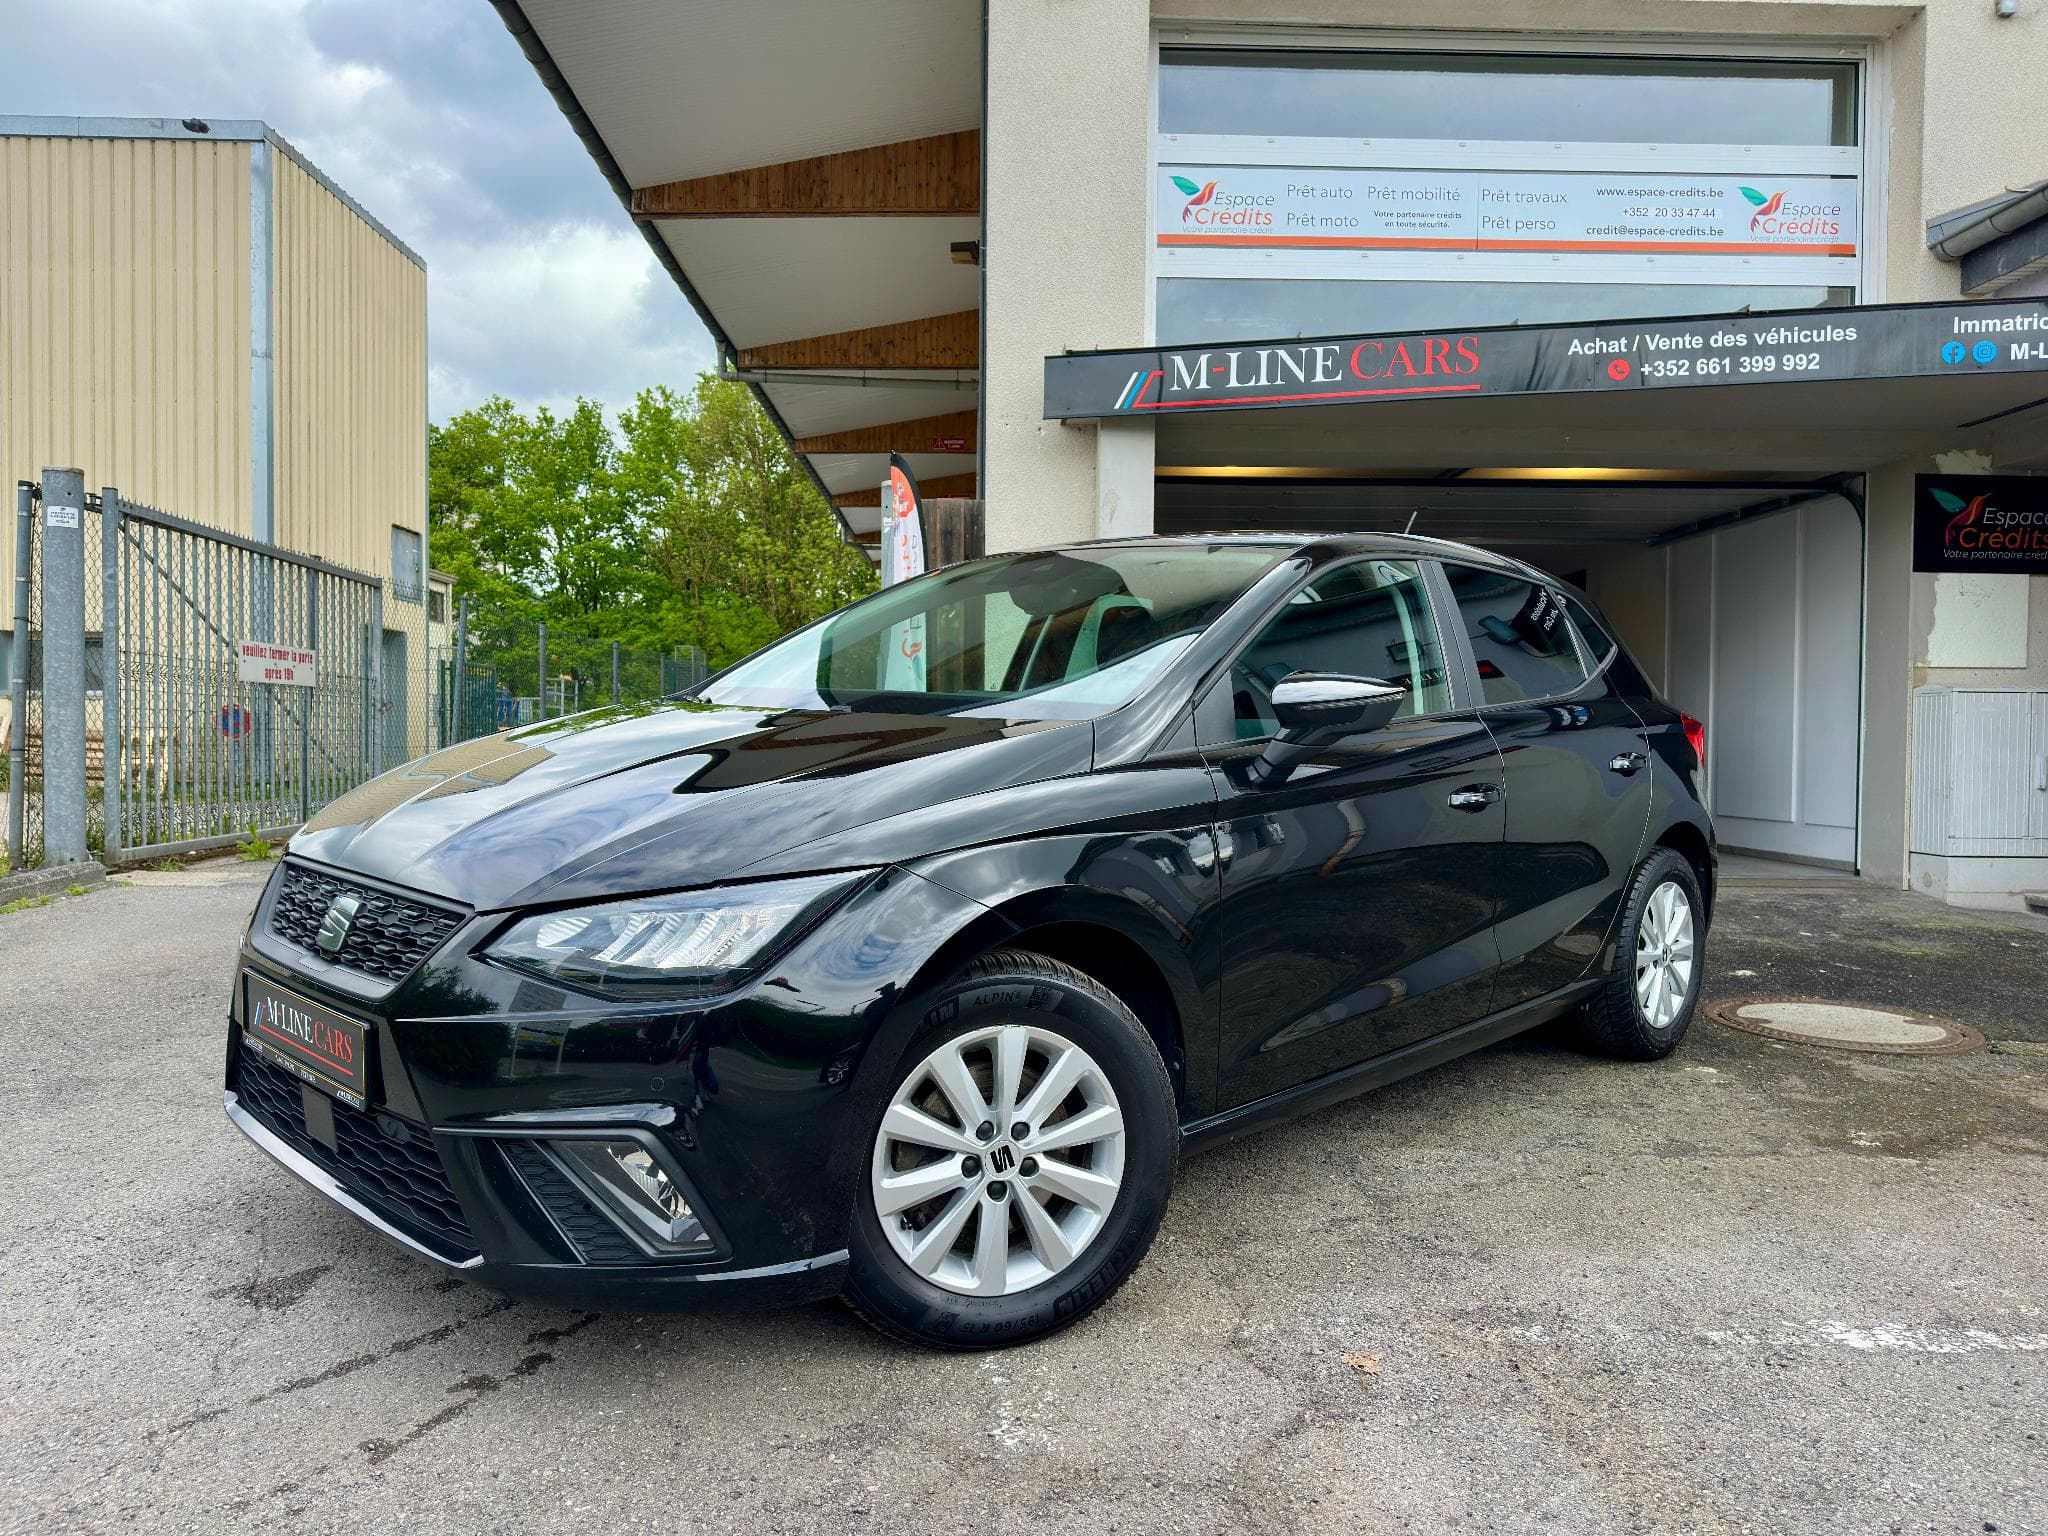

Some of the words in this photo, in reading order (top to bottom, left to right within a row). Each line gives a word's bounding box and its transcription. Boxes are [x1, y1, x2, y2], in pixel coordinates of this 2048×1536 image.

[1287, 184, 1316, 199] Prêt
[1320, 186, 1353, 199] auto
[1367, 186, 1396, 200] Prêt
[1401, 186, 1461, 201] mobilité
[1482, 188, 1511, 203] Prêt
[1514, 191, 1568, 204] travaux
[1596, 187, 1724, 199] www.espace-credits.be
[1214, 191, 1275, 209] Espace
[1194, 207, 1273, 226] Crédits
[1374, 210, 1394, 218] Votre
[1396, 211, 1435, 220] partenaire
[1623, 207, 1649, 217] +352
[1654, 207, 1668, 217] 20
[1671, 208, 1684, 218] 33
[1686, 208, 1700, 218] 47
[1702, 208, 1715, 218] 44
[1782, 202, 1841, 219] Espace
[1287, 212, 1316, 227] Prêt
[1320, 215, 1359, 227] moto
[1396, 221, 1417, 229] toute
[1482, 215, 1511, 230] Prêt
[1514, 219, 1556, 233] perso
[1762, 217, 1840, 236] Crédits
[1586, 225, 1724, 237] credit@espace-credits.be
[1567, 336, 1628, 356] Achat
[1632, 334, 1640, 352] /
[1644, 332, 1704, 351] Vente
[1709, 330, 1748, 348] des
[1754, 324, 1857, 346] véhicules
[1169, 345, 1343, 391] M-LINE
[1350, 335, 1480, 380] CARS
[1640, 359, 1690, 377] +352
[1696, 356, 1730, 375] 661
[1739, 355, 1776, 373] 399
[1782, 352, 1820, 371] 992
[269, 647, 290, 661] fermer
[313, 1019, 353, 1063] CARS
